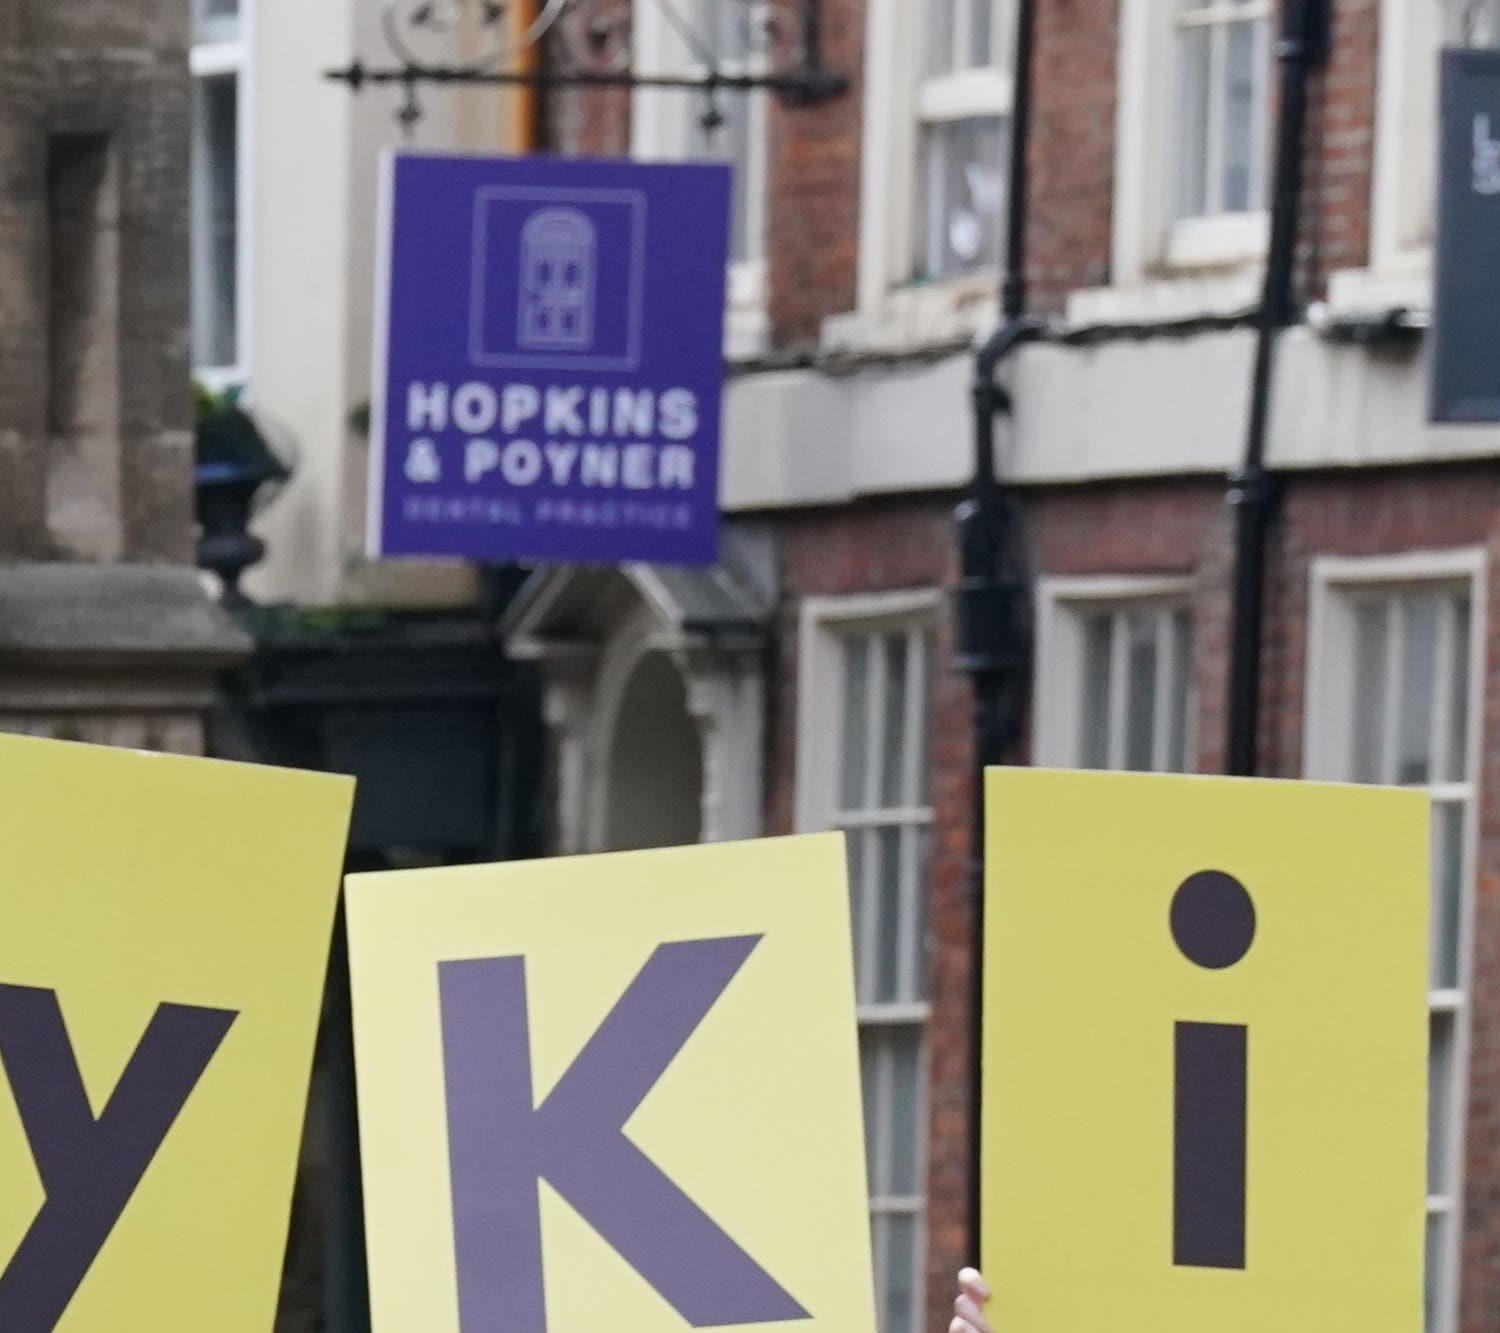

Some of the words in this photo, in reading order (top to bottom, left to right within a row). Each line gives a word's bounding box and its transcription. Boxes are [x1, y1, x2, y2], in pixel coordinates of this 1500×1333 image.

[406, 380, 699, 440] HOPKINS
[403, 435, 441, 485] &
[463, 436, 695, 490] POYNER
